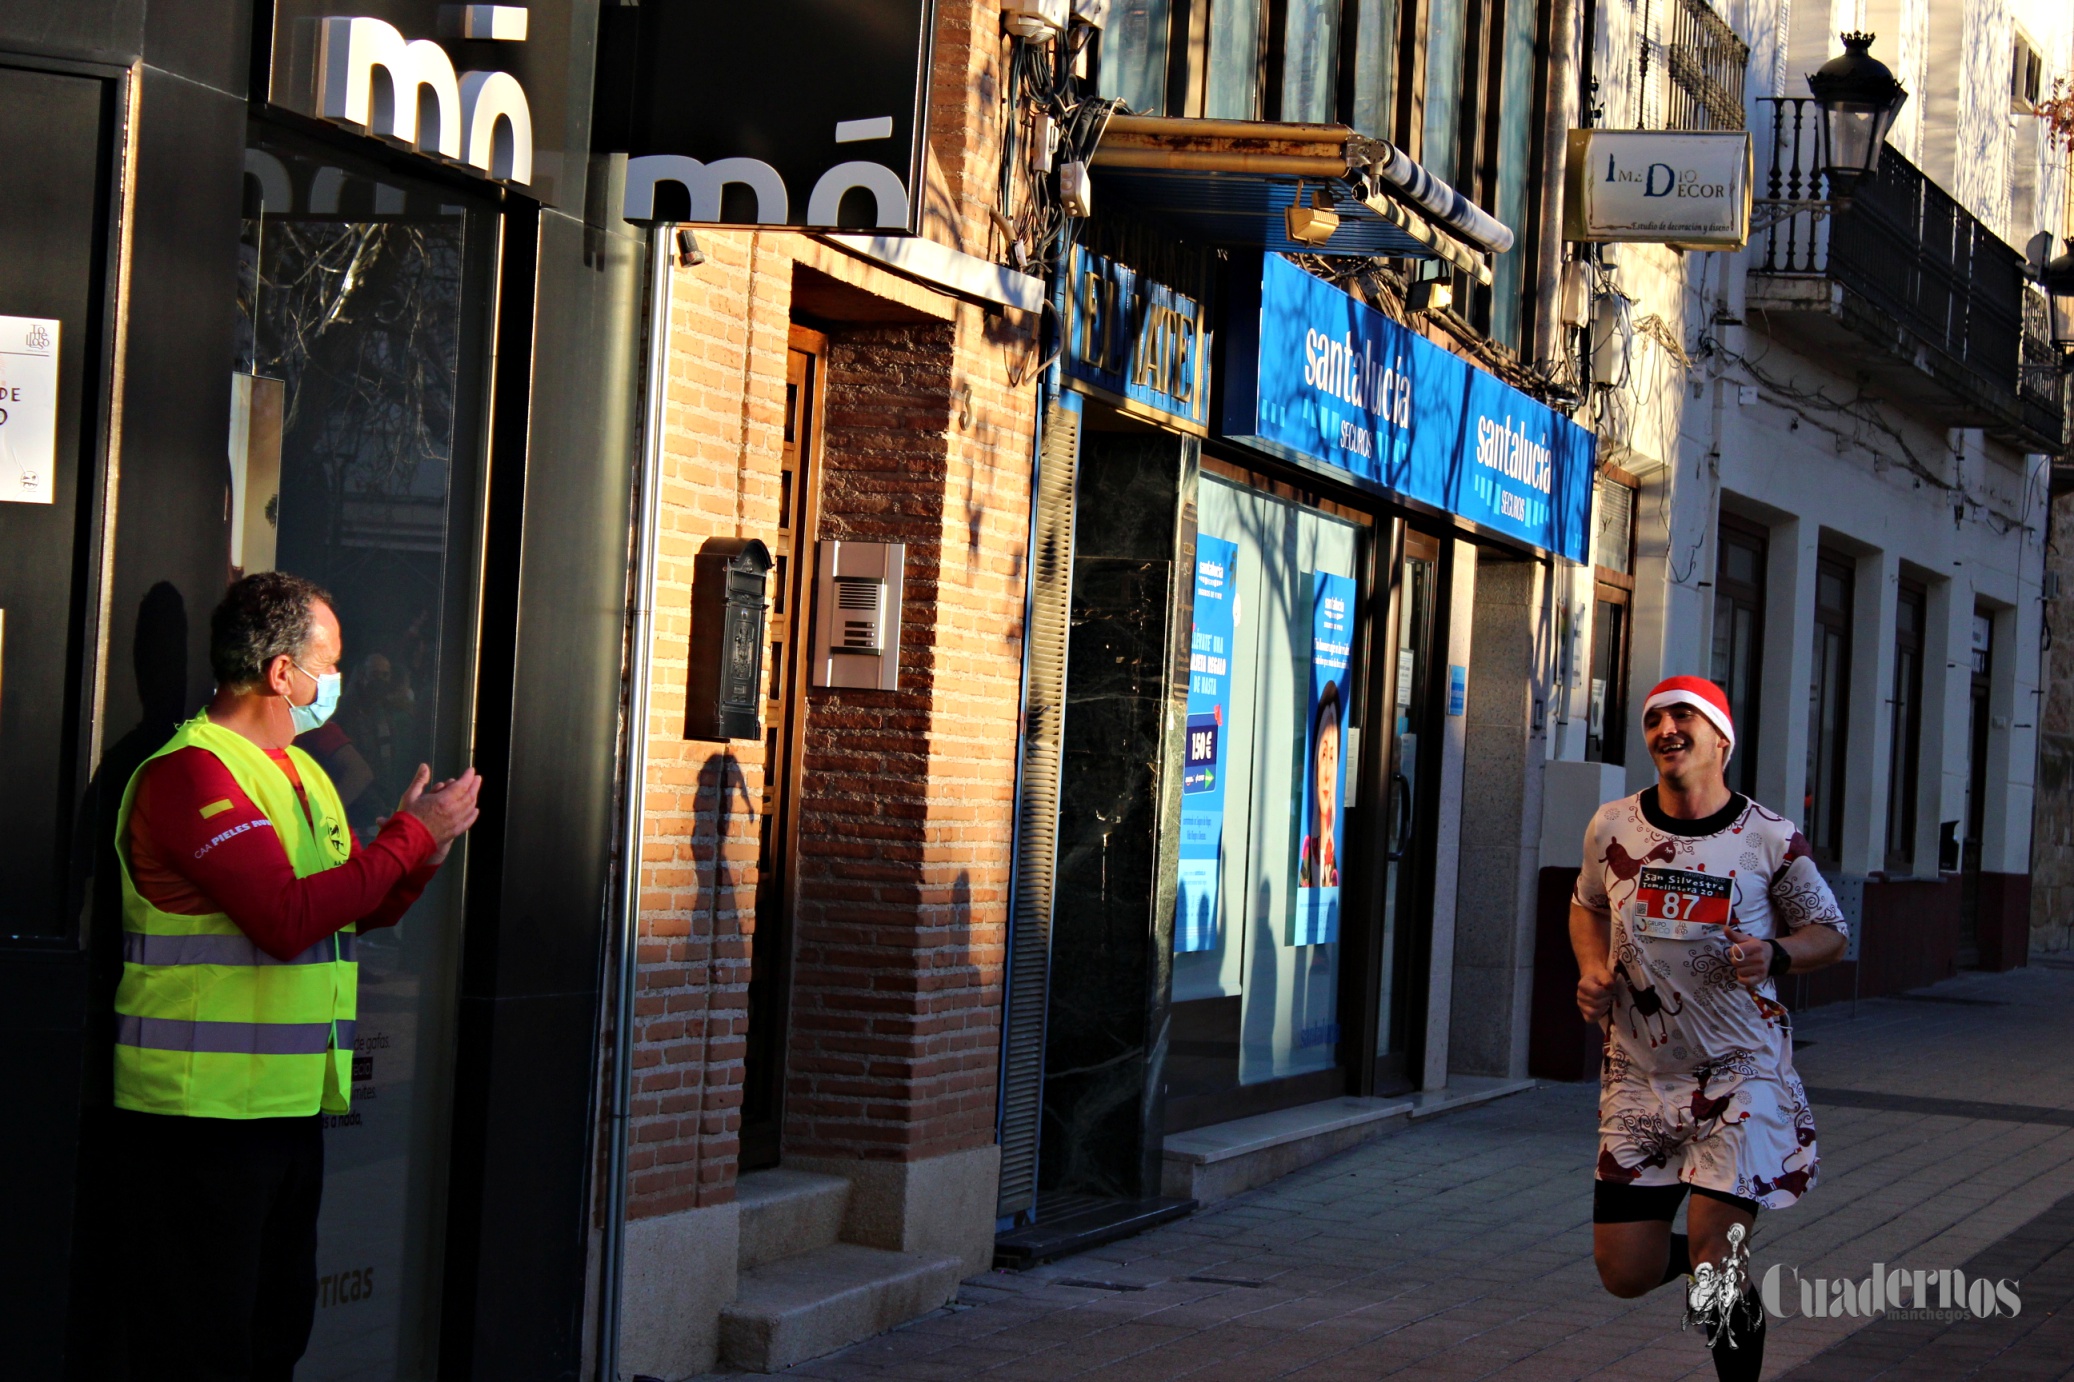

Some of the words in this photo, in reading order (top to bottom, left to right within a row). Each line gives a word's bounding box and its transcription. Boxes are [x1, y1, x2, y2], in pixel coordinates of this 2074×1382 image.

[1631, 221, 1657, 232] Estudio
[1658, 221, 1667, 231] de
[1702, 223, 1708, 234] y
[1081, 270, 1123, 377] EL
[1304, 327, 1412, 430] santalucía
[1340, 418, 1374, 460] SEGUROS
[1475, 414, 1551, 495] santalucía
[1500, 488, 1526, 523] SEGUROS
[211, 822, 250, 847] PIELES
[1643, 873, 1663, 882] San
[1662, 892, 1700, 920] 87
[366, 1032, 391, 1054] gafas.
